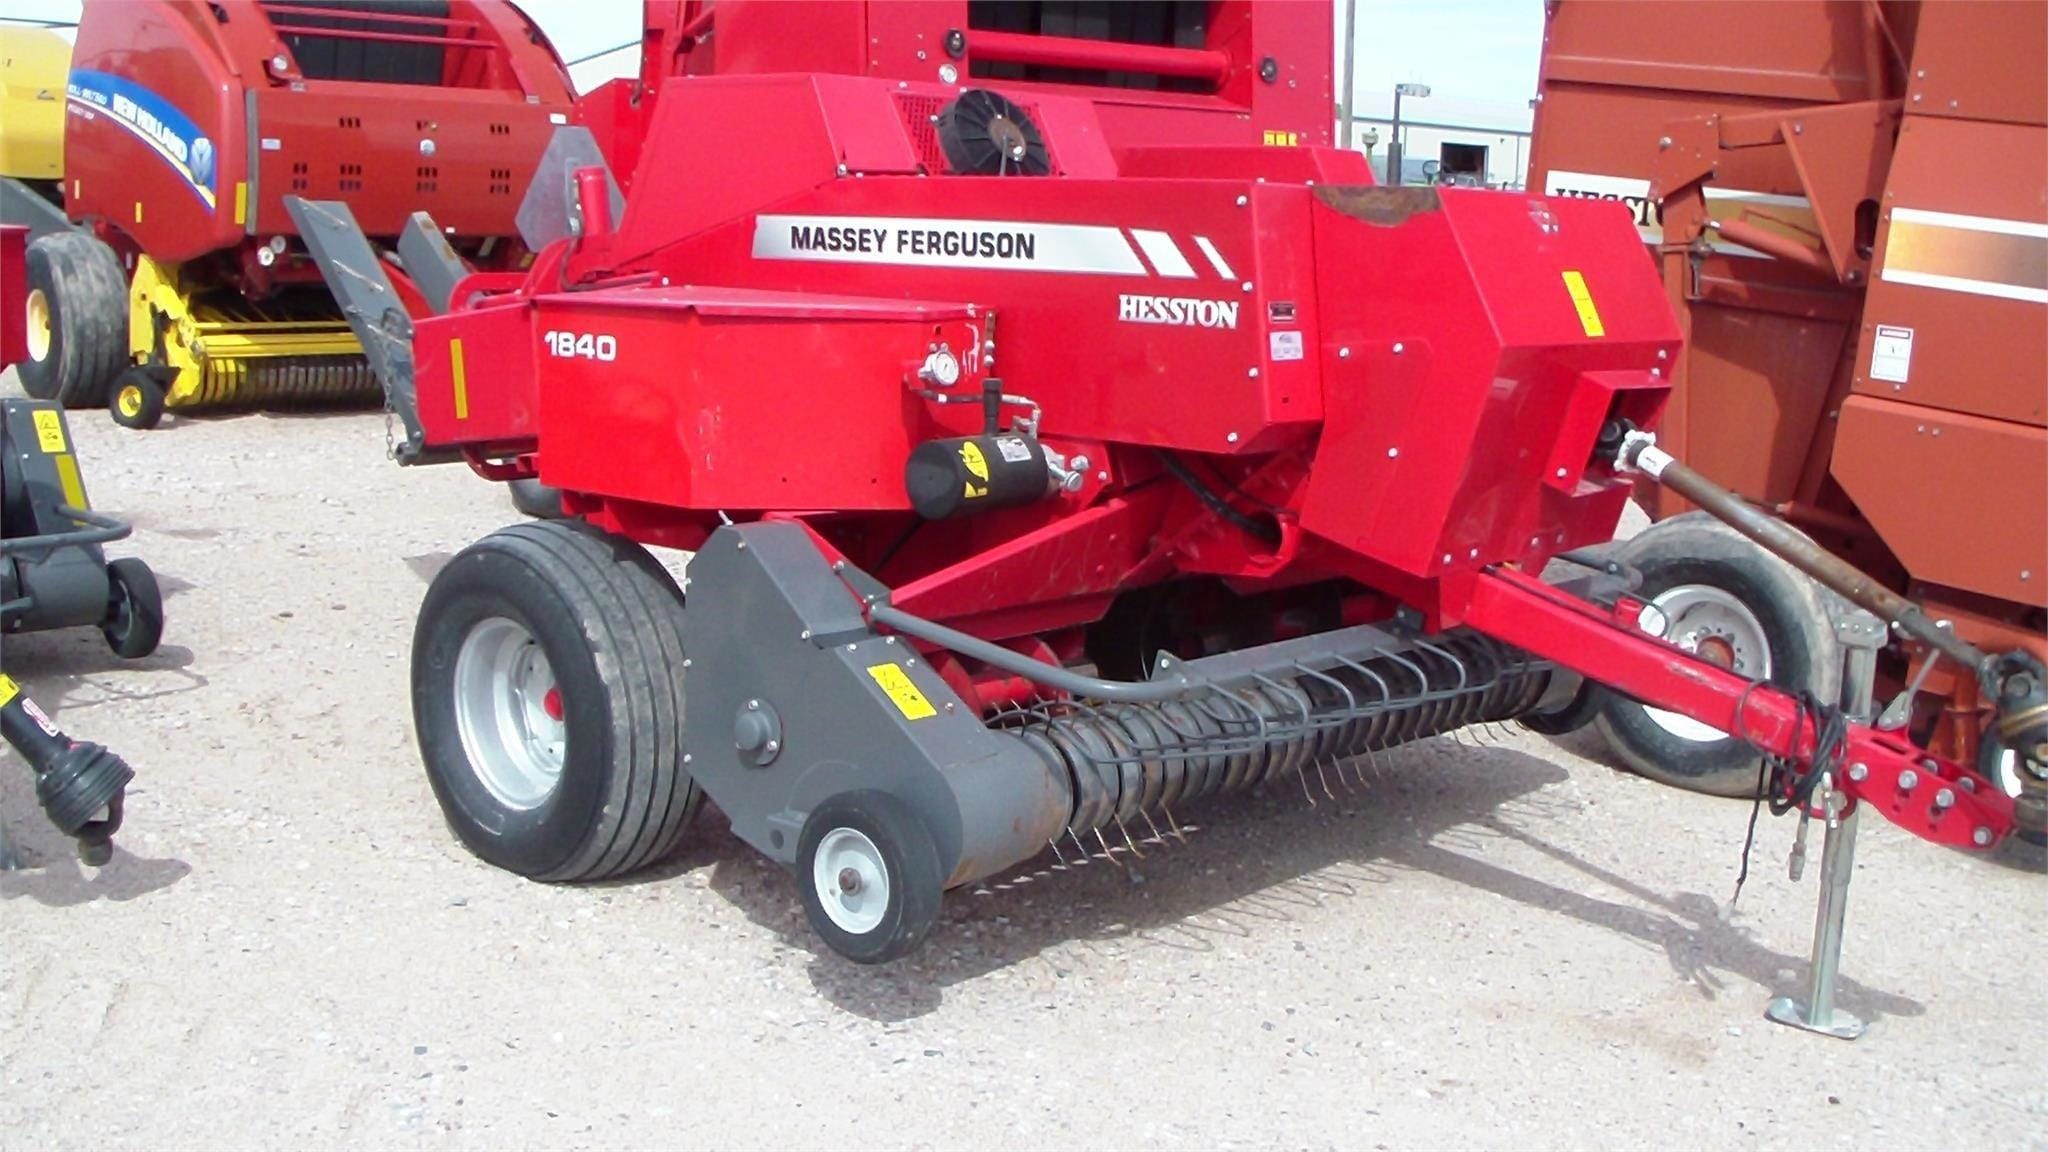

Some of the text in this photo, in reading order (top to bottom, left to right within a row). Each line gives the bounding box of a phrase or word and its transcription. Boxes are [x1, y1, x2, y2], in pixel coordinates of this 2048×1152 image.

[113, 93, 137, 122] NEW
[136, 107, 188, 162] HOLLAND
[790, 225, 1035, 260] MASSEY FERGUSON
[1118, 294, 1239, 329] HESSTON
[544, 330, 617, 361] 1840
